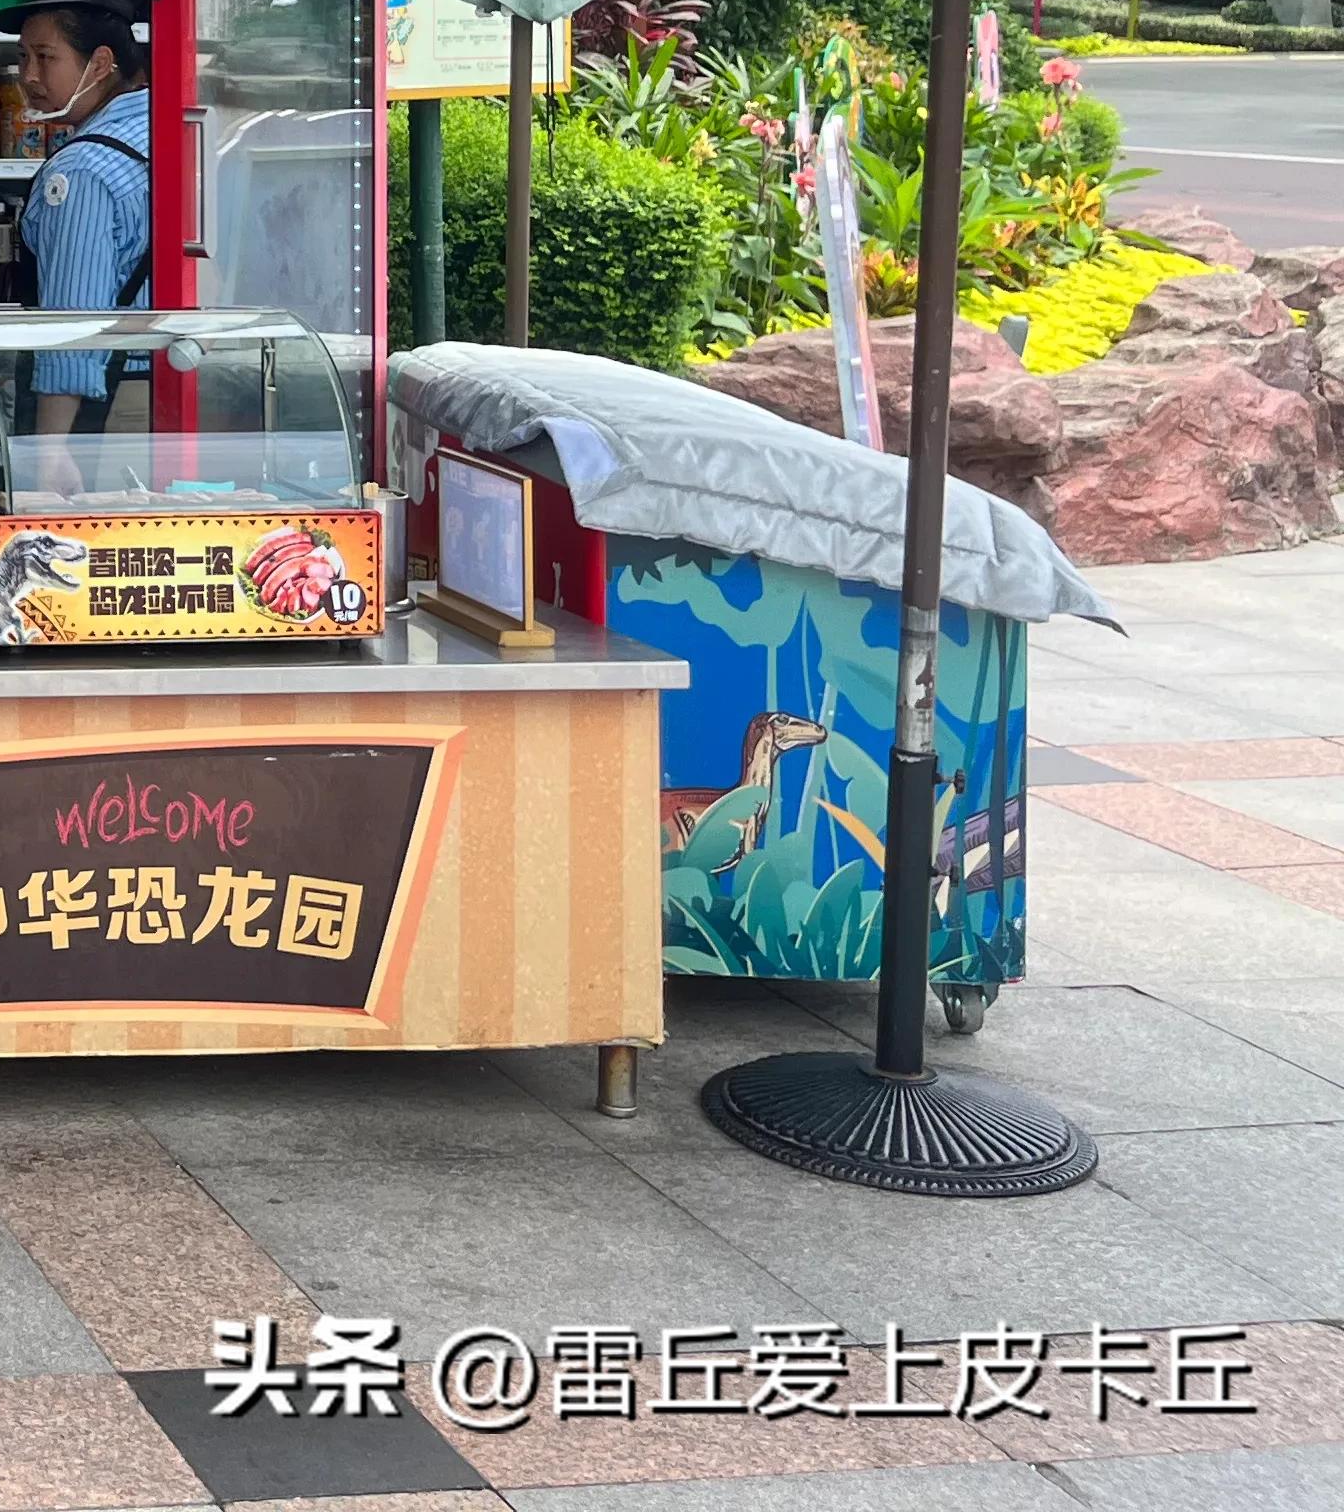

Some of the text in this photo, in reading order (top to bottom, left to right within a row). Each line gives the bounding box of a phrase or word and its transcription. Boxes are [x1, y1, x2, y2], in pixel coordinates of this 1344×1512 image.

[88, 546, 234, 578] 香肠滚一滚
[88, 584, 235, 616] 恐龙站不稳
[331, 583, 361, 610] 10
